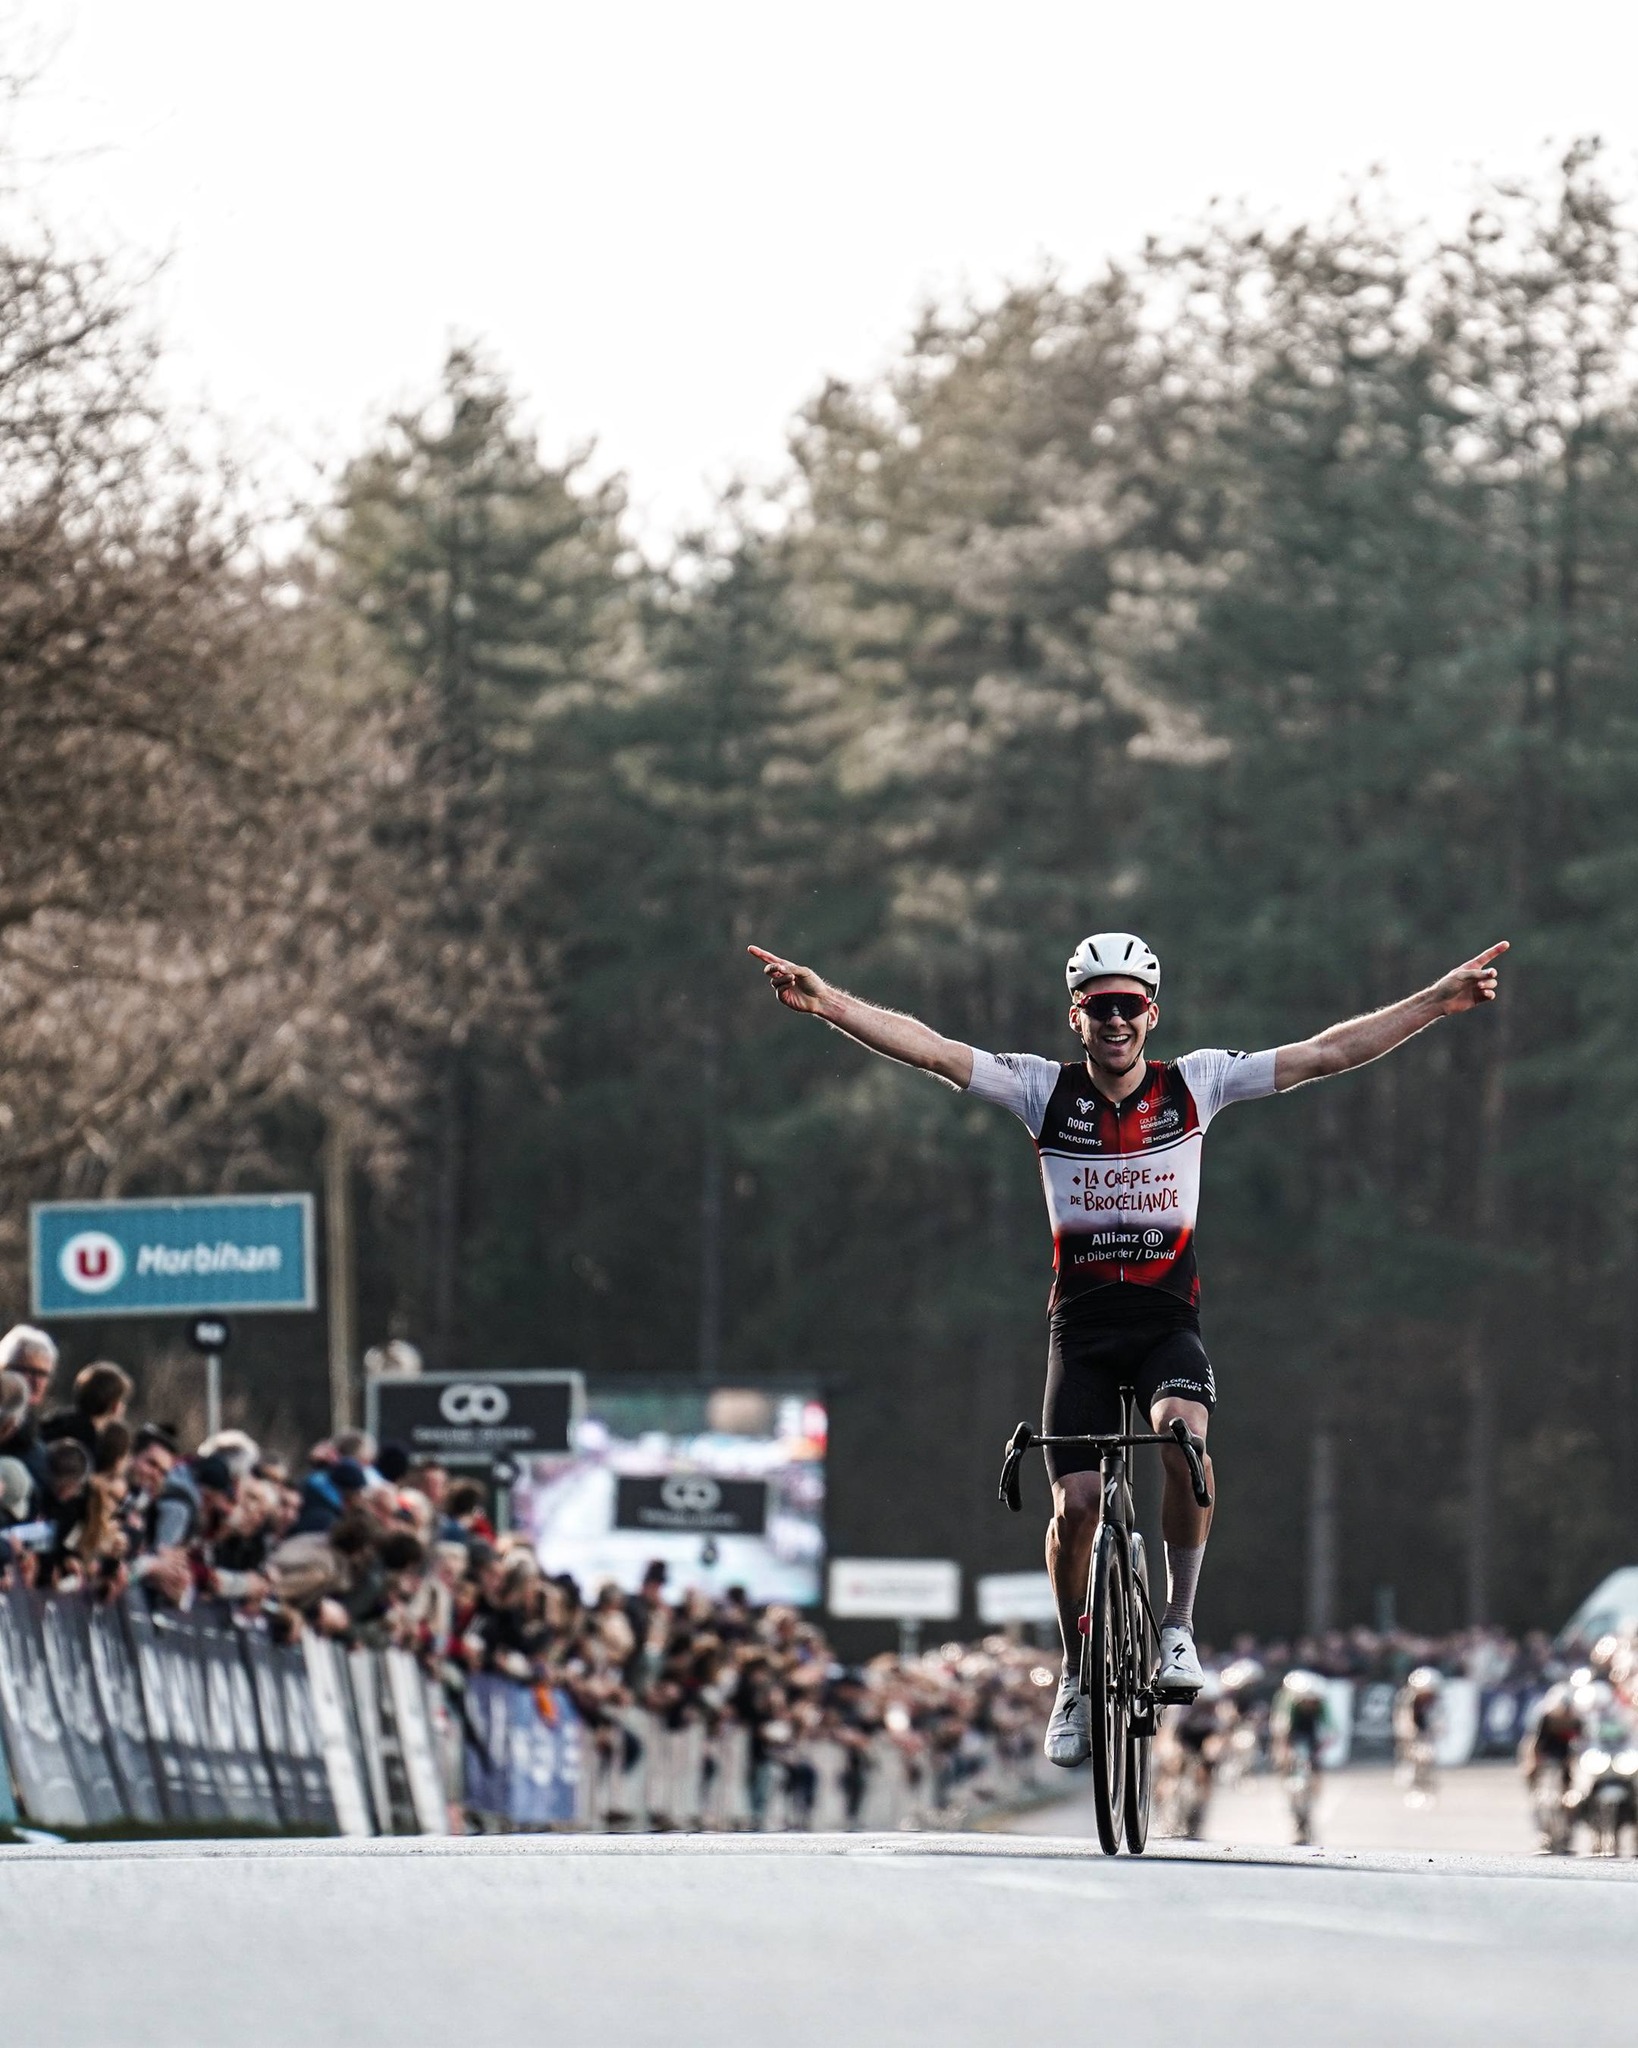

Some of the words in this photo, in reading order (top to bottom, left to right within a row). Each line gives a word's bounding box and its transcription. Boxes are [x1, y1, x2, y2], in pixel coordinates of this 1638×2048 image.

[1084, 1168, 1099, 1189] LA
[1070, 1195, 1082, 1206] DE
[1091, 1231, 1140, 1247] Allianz
[77, 1249, 108, 1279] U
[135, 1242, 283, 1277] Morbihan
[1073, 1254, 1085, 1265] Le
[1087, 1248, 1134, 1262] Diberder
[1135, 1248, 1142, 1261] /
[1145, 1249, 1177, 1261] David
